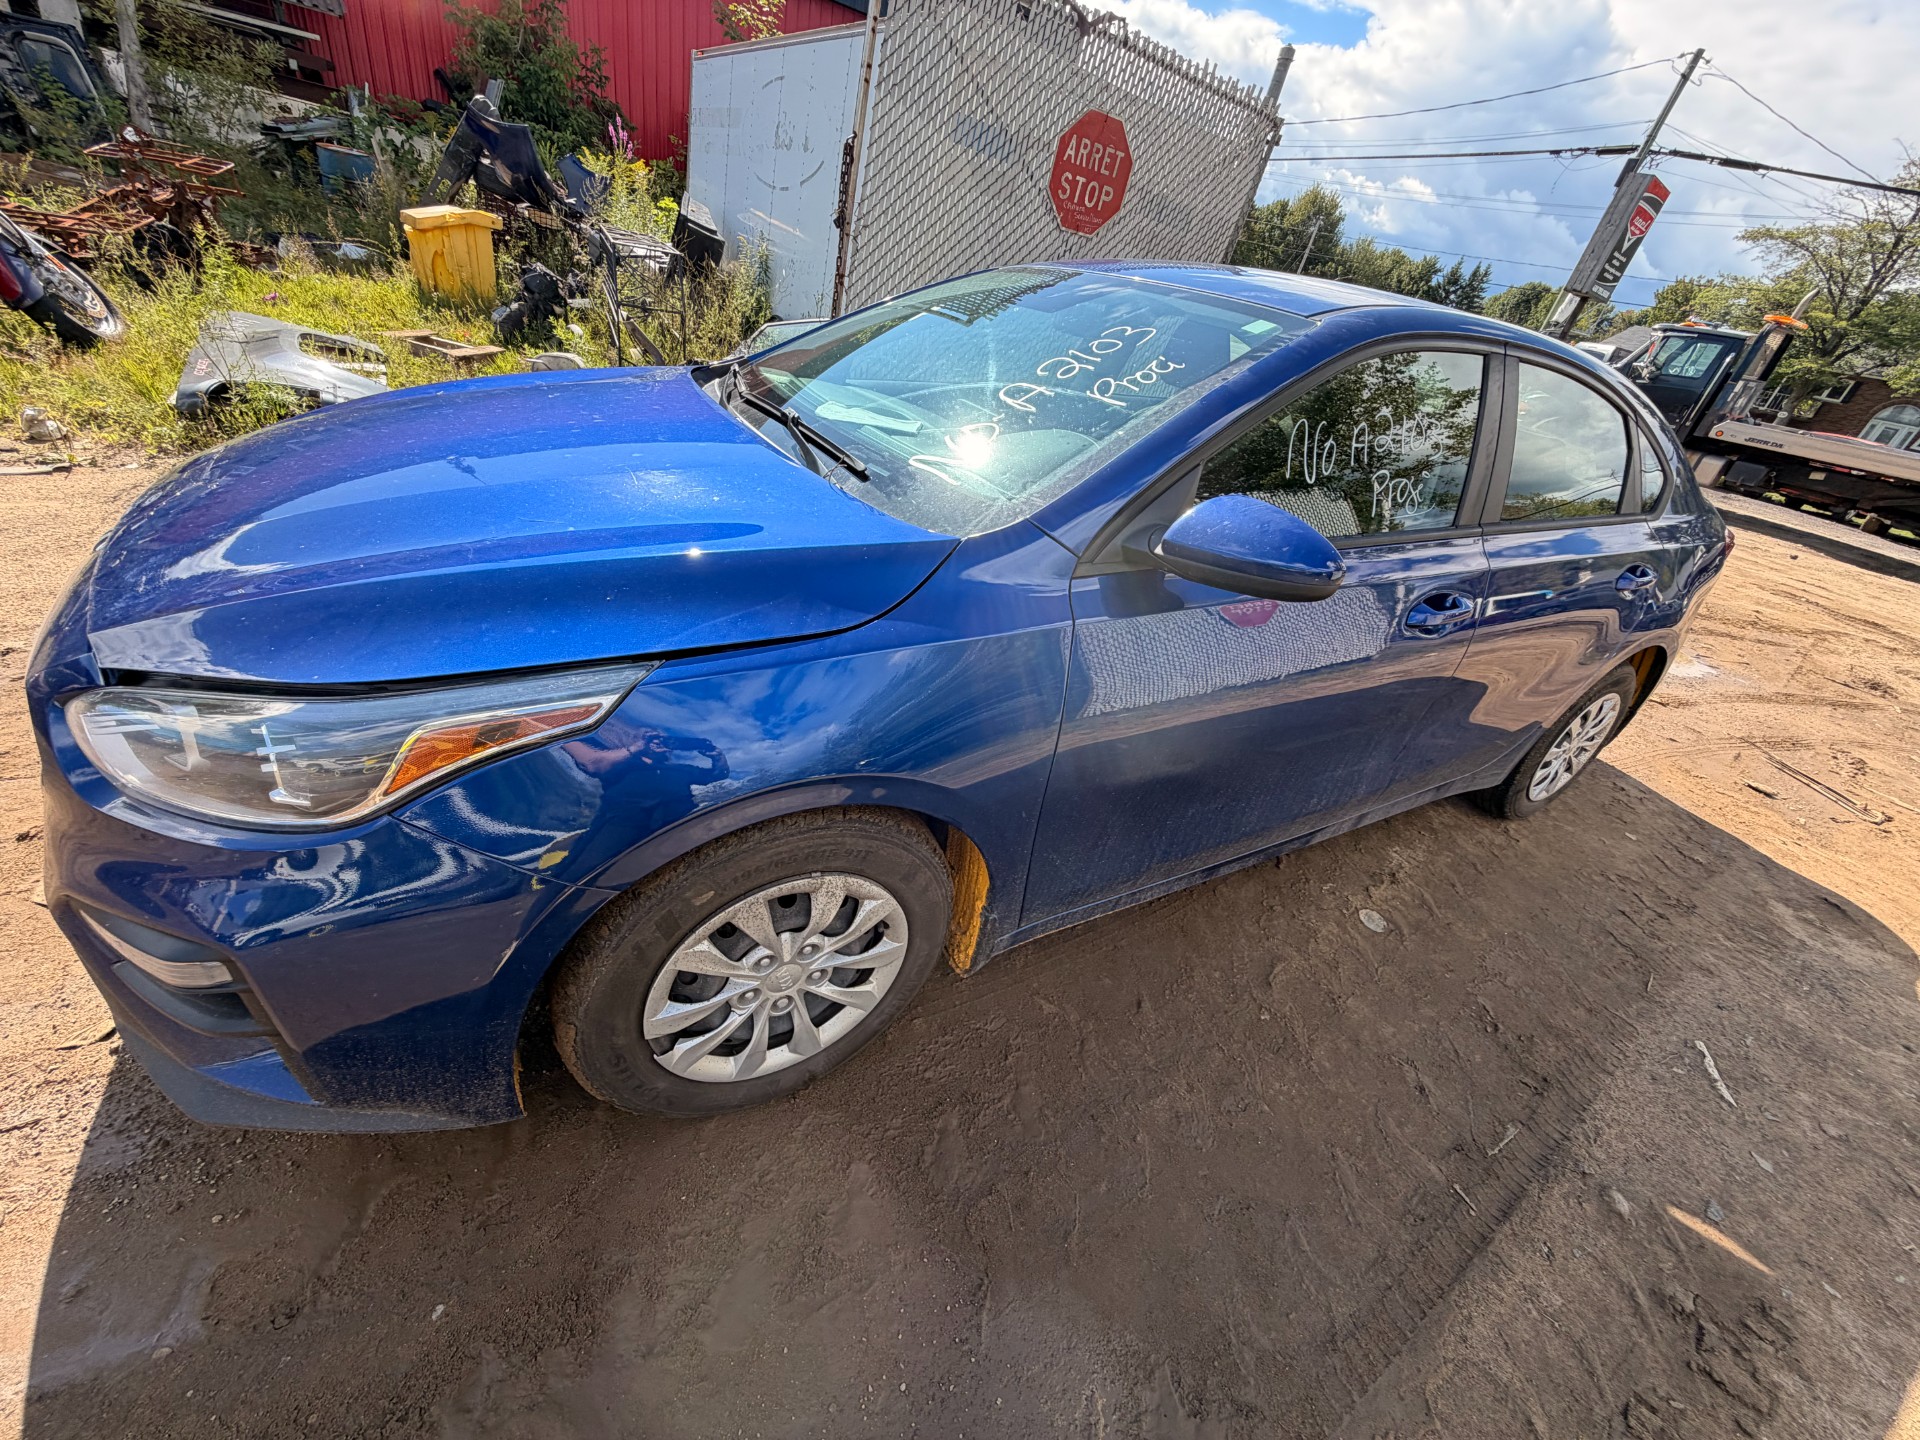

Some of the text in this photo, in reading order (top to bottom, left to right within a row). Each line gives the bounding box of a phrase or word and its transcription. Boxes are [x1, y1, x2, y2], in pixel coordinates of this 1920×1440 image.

[1063, 134, 1125, 178] ARRÊT
[1058, 172, 1114, 211] STOP
[1286, 418, 1336, 484] No
[776, 967, 794, 990] KIA
